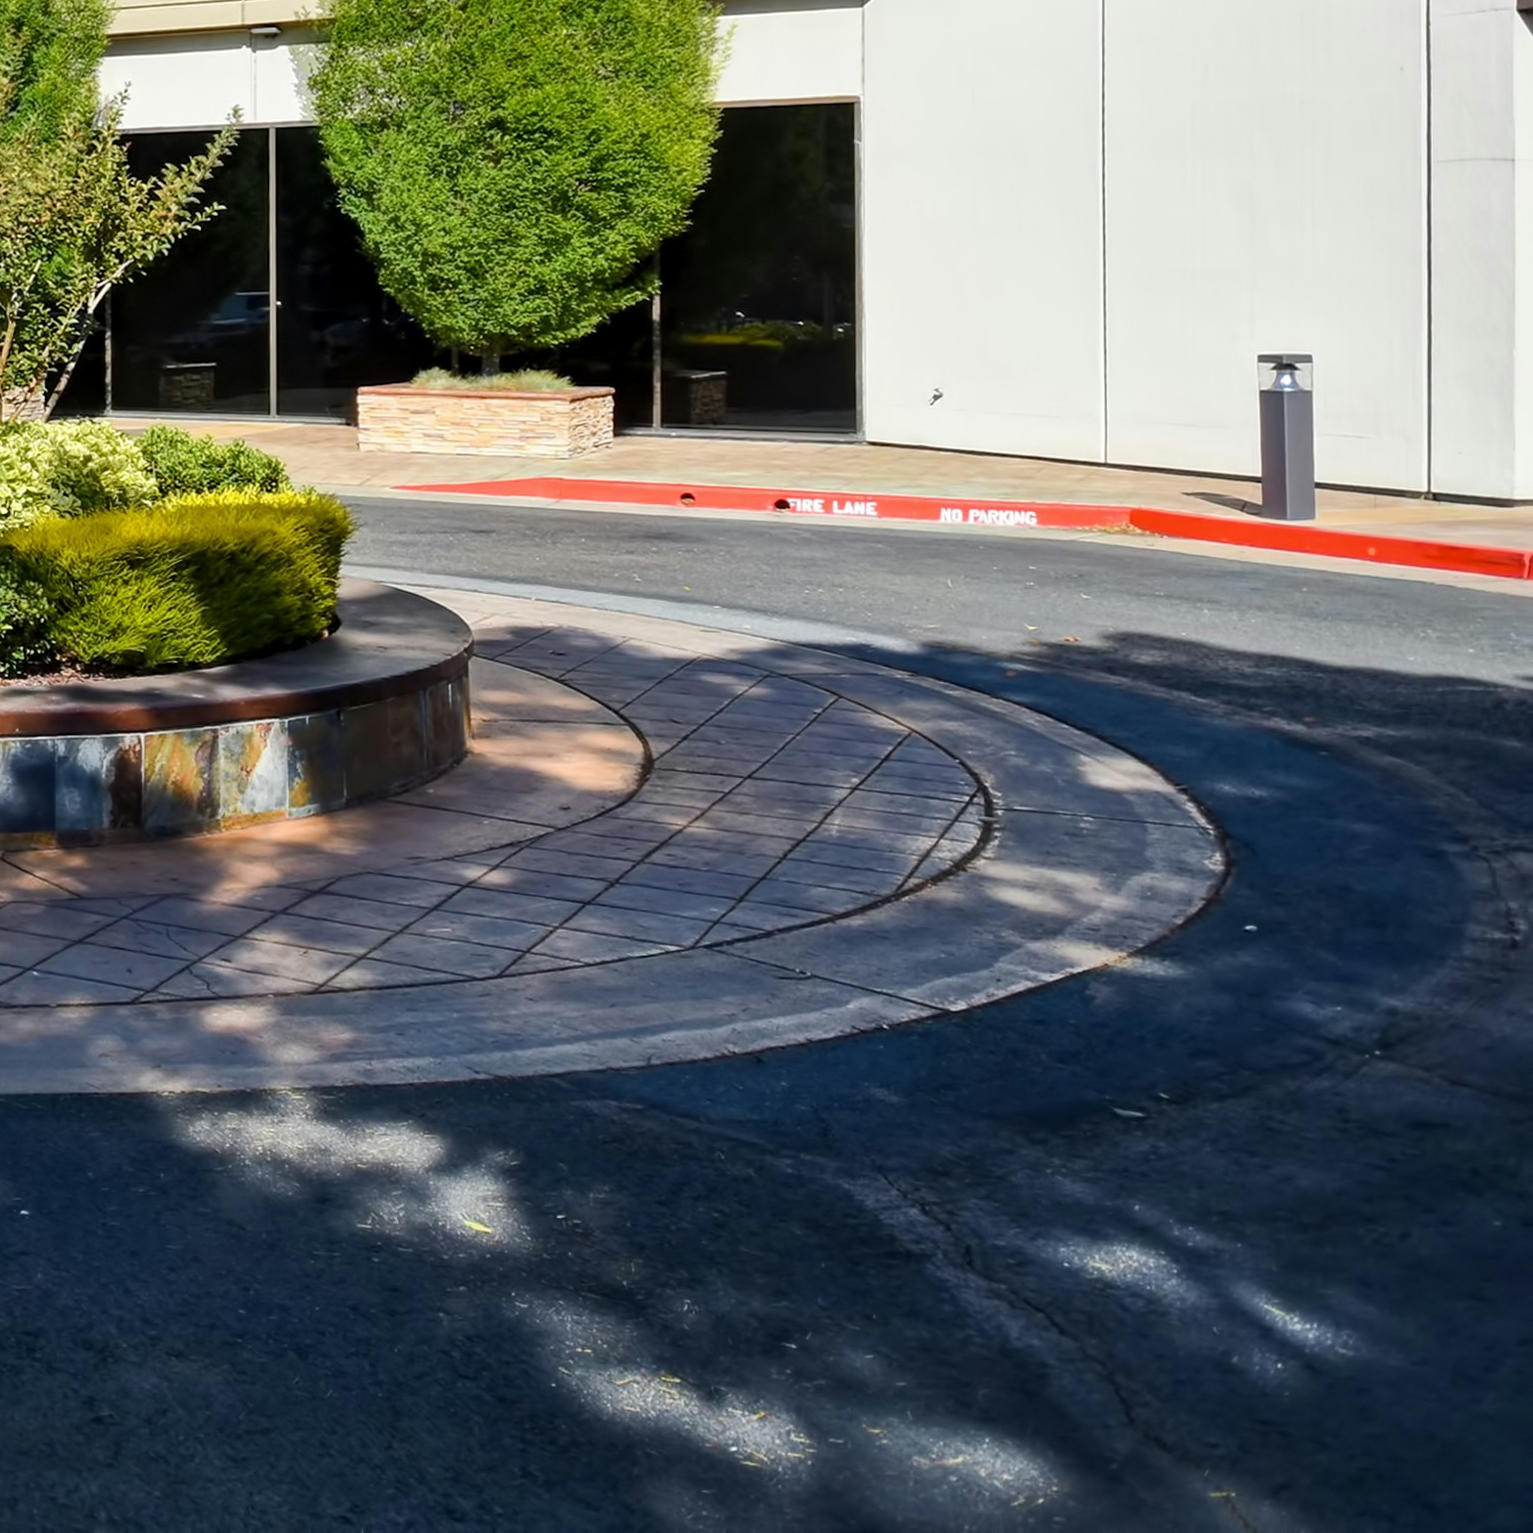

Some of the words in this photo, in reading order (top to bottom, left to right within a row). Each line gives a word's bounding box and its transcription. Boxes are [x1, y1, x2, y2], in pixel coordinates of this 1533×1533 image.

[787, 497, 825, 514] FIRE
[832, 500, 878, 516] LANE
[940, 507, 963, 523] NO
[968, 508, 1038, 526] PARKING
